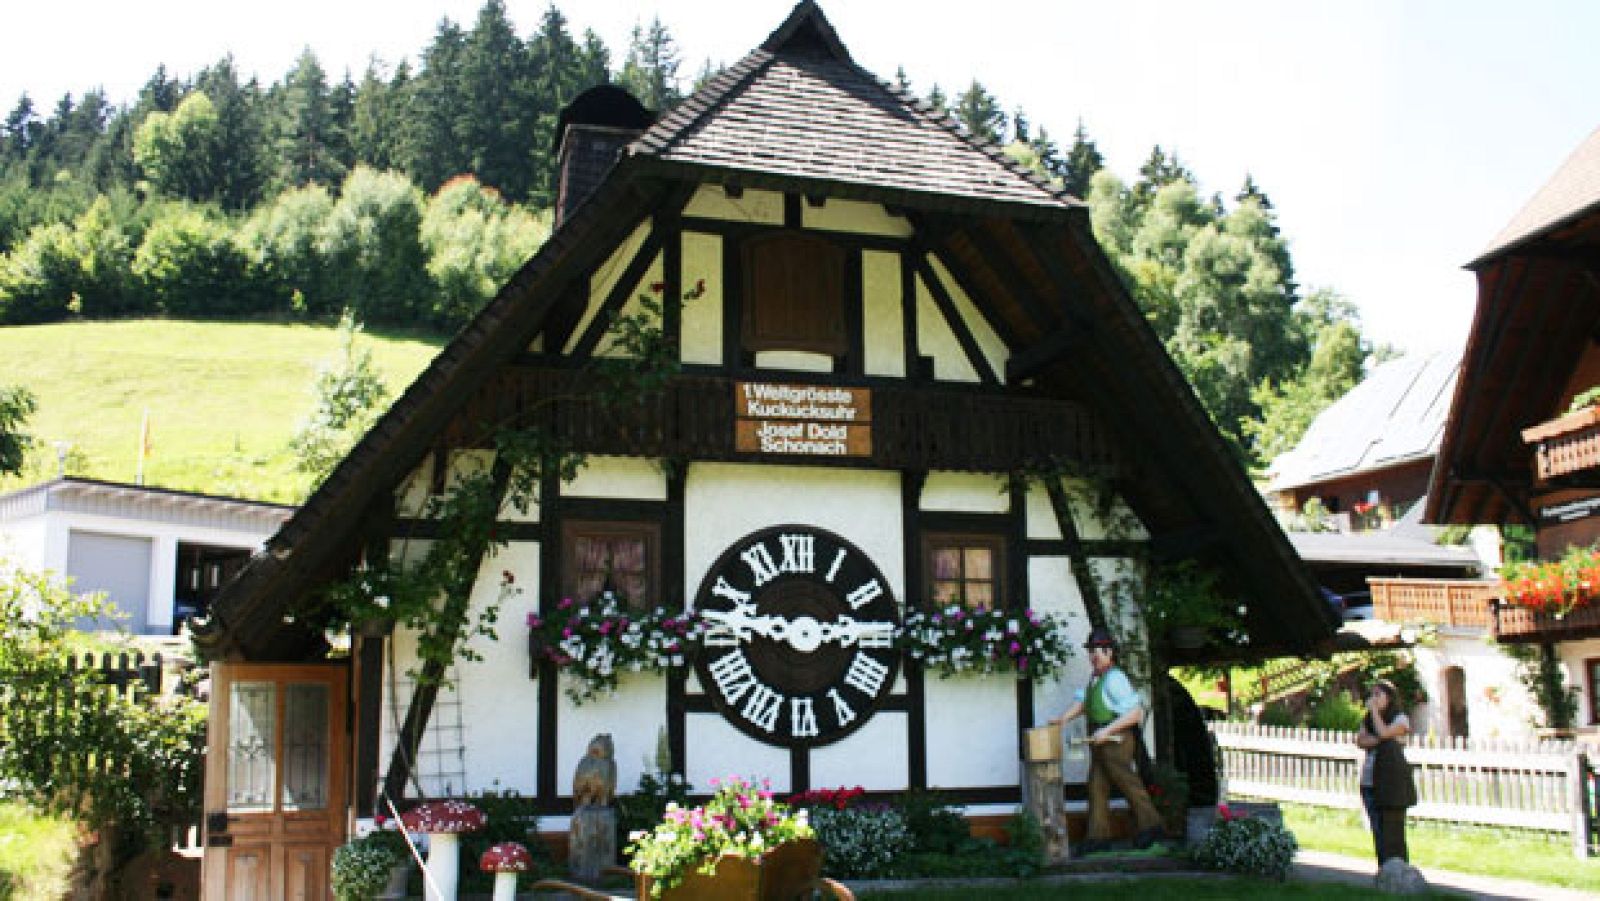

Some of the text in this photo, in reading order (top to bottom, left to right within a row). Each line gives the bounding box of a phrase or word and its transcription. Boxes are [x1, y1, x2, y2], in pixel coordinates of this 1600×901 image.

[747, 400, 857, 419] Kuckucksuhr
[756, 421, 847, 440] Josef Dold
[760, 437, 847, 454] Schonach
